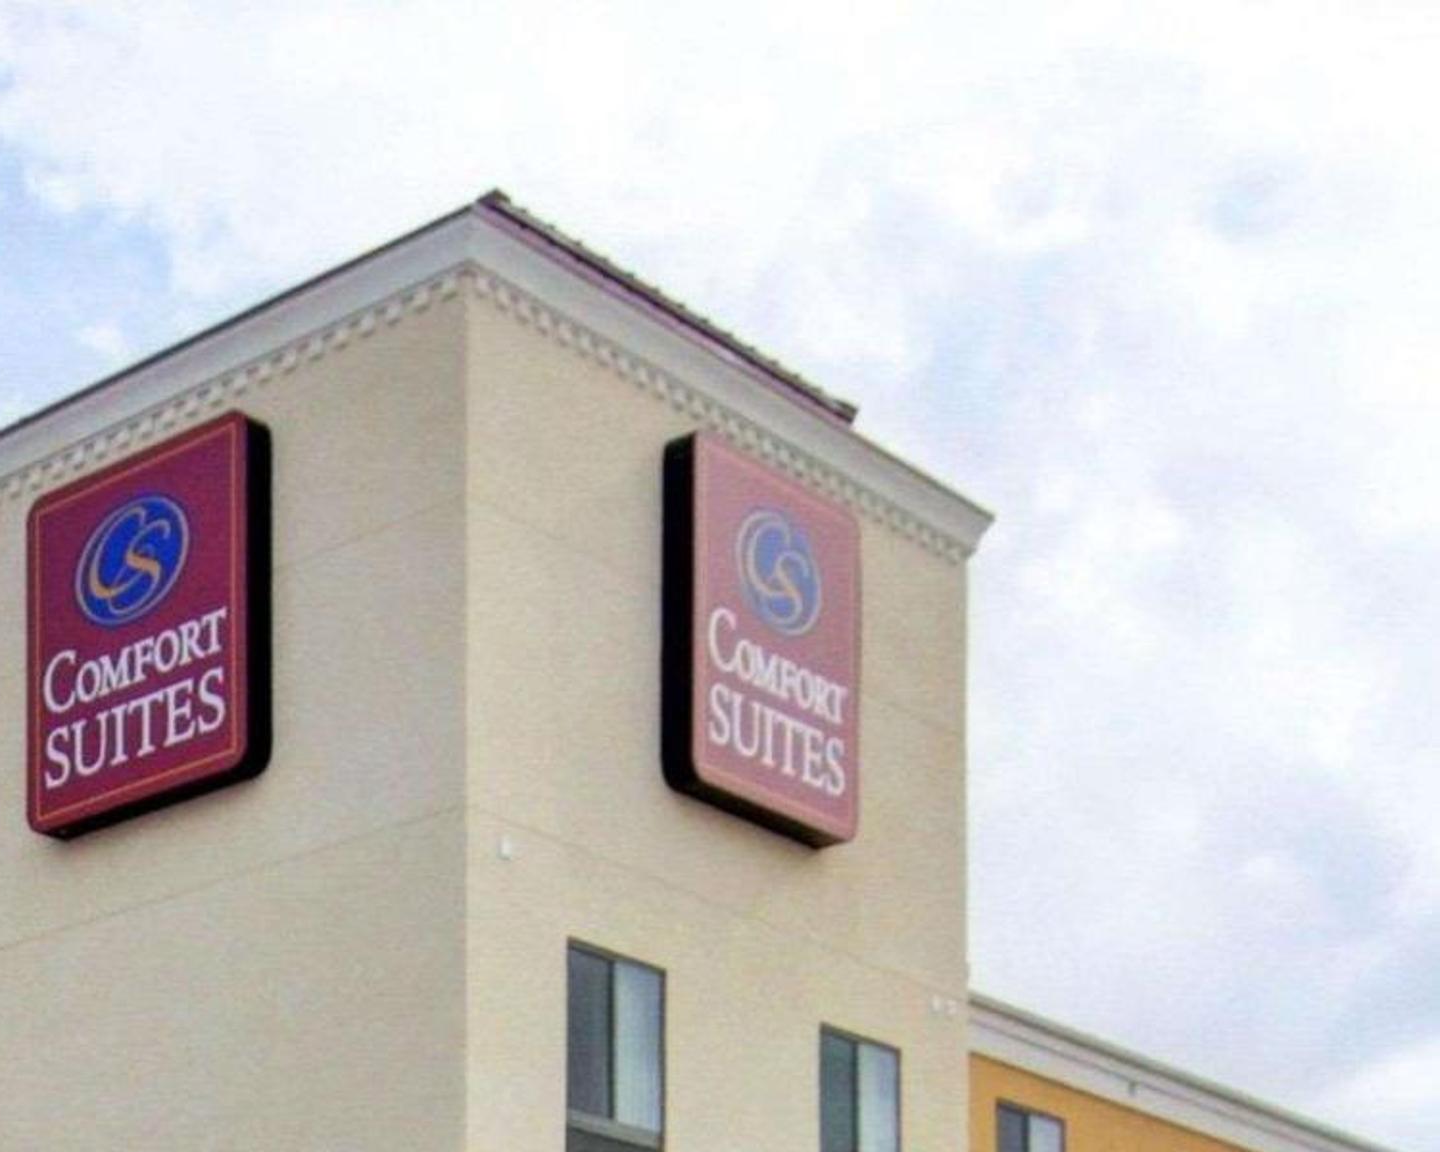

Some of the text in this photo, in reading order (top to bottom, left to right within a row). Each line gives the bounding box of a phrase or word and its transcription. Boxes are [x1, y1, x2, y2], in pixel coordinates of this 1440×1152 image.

[42, 607, 228, 714] COMFORT
[707, 607, 847, 725] COMFORT
[44, 668, 227, 790] SUITES
[708, 682, 846, 797] SUITES
